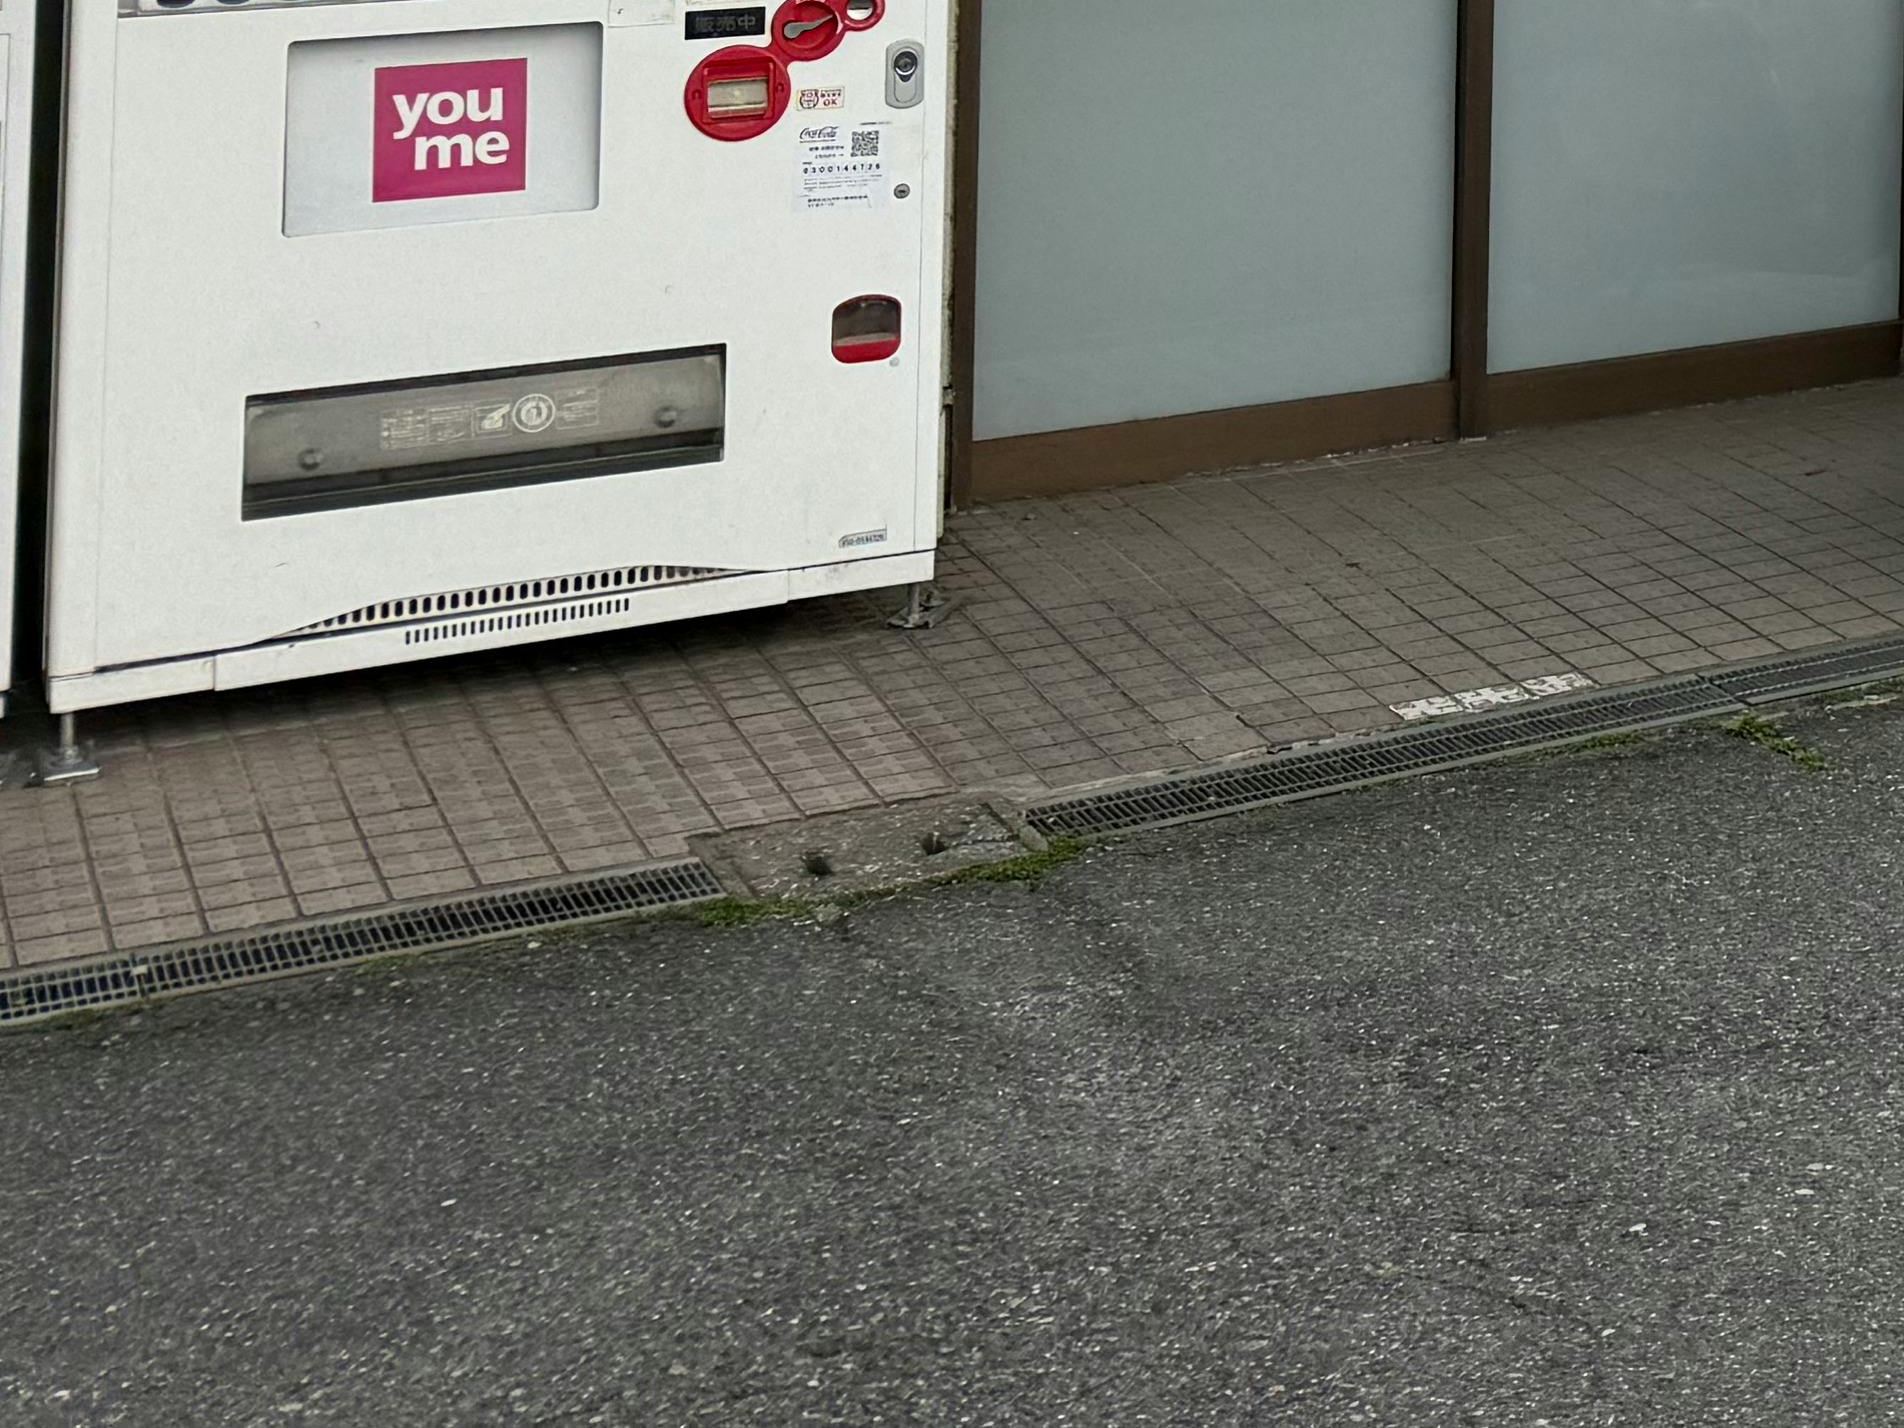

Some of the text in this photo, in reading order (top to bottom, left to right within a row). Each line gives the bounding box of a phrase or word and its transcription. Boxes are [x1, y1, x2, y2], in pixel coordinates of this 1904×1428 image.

[696, 14, 756, 33] 販売中
[393, 86, 504, 140] you
[414, 132, 510, 171] me
